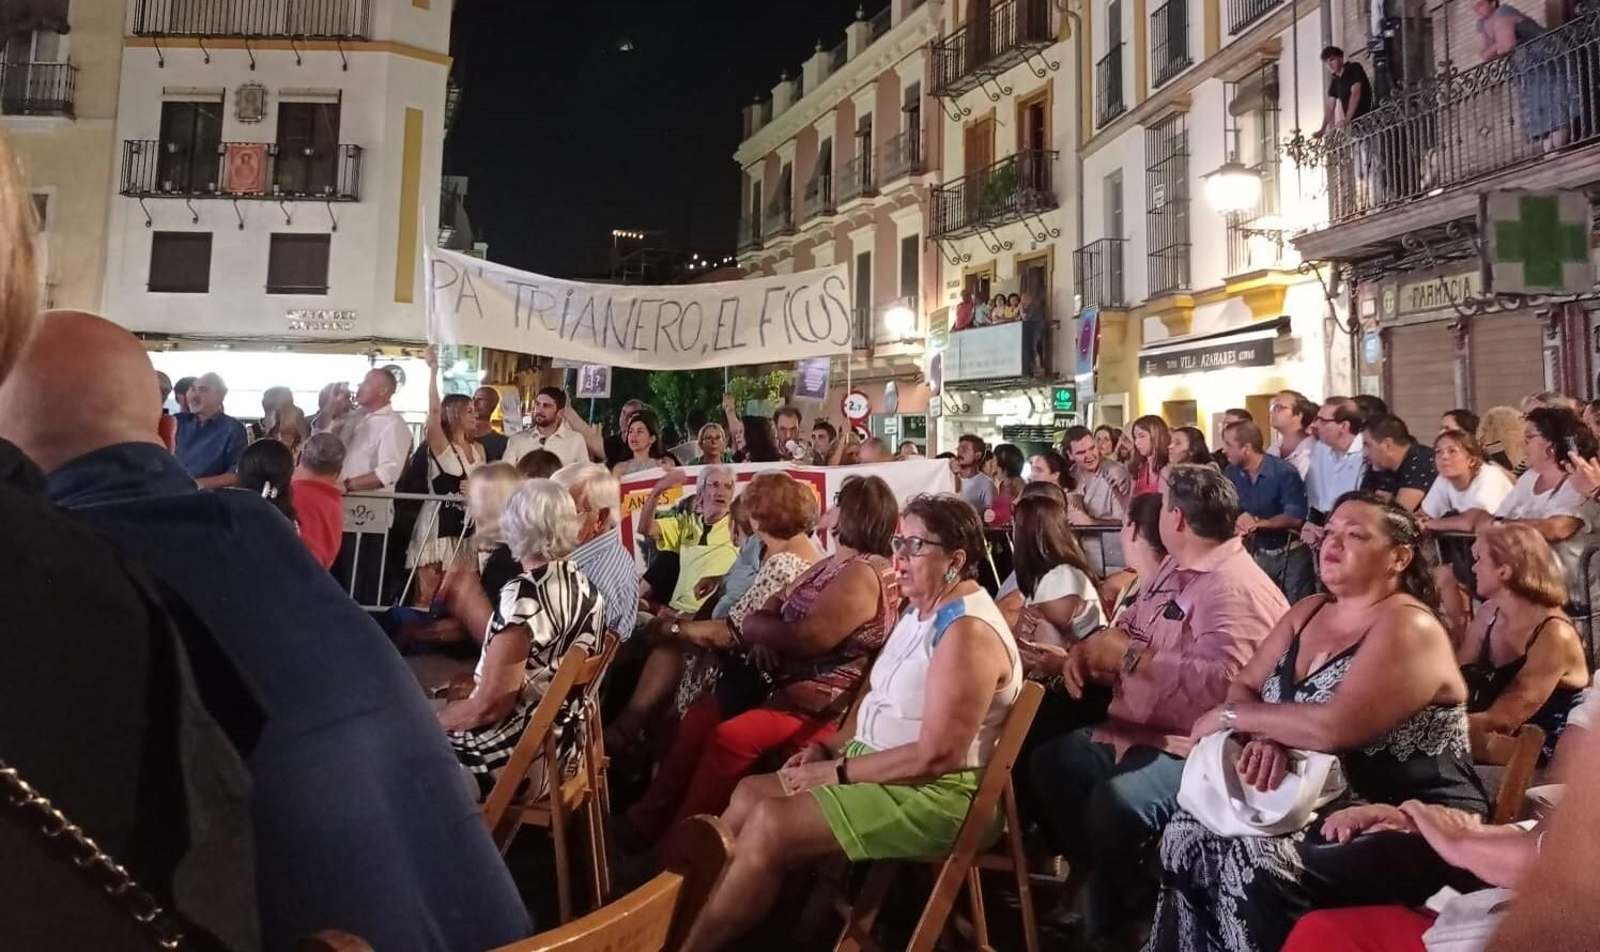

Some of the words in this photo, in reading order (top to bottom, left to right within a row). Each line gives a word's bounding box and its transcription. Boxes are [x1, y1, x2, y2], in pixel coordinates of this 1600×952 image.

[1412, 276, 1473, 309] FARMACIA
[714, 296, 747, 350] EL
[759, 275, 850, 347] FICUS
[628, 491, 670, 510] ANS
